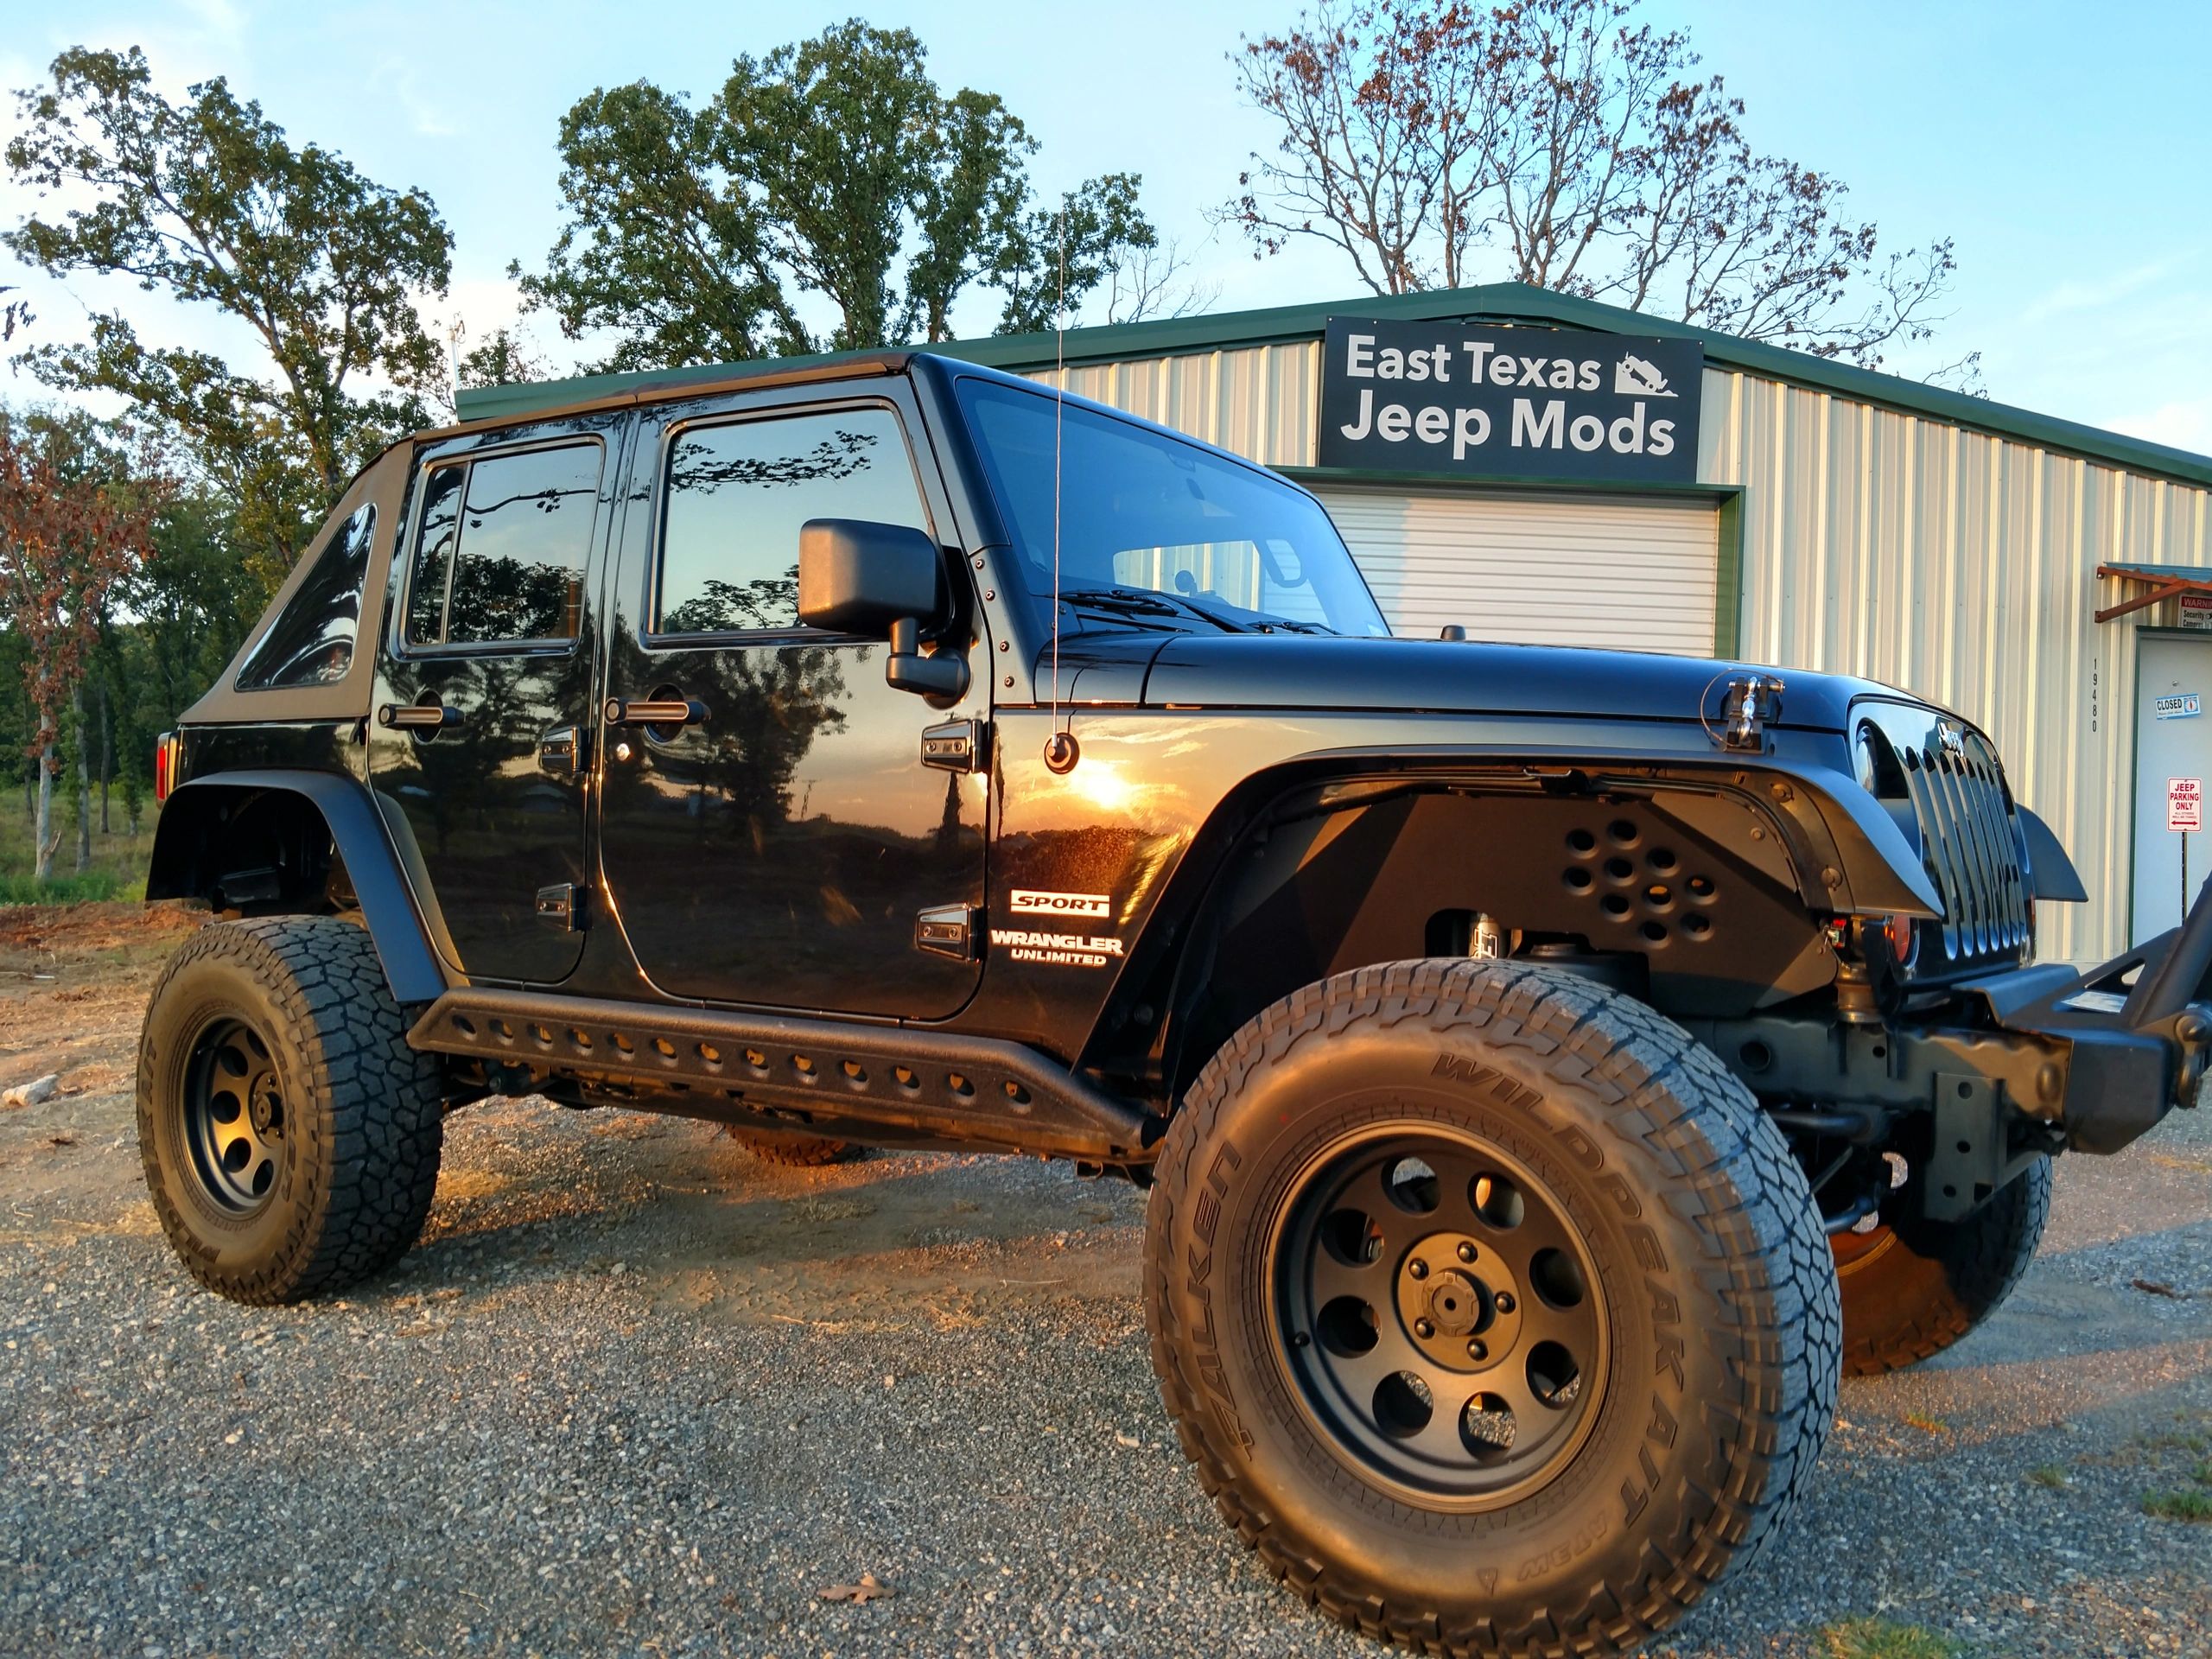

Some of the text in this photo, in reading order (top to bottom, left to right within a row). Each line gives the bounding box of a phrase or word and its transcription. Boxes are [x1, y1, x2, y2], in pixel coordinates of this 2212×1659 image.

[1346, 334, 1602, 391] East Texas
[1340, 389, 1676, 461] Jeep Mods
[2183, 610, 2204, 620] Security
[2157, 698, 2183, 711] CLOSED
[2175, 783, 2196, 791] JEEP
[2170, 792, 2199, 801] PARKING
[2176, 802, 2193, 810] ONLY
[1012, 894, 1109, 912] SPORT
[991, 929, 1124, 956] WRANGLER
[1011, 949, 1107, 966] UNLIMITED
[1430, 1051, 1684, 1391] WILDPEAK
[1187, 1140, 1255, 1462] FALKEN
